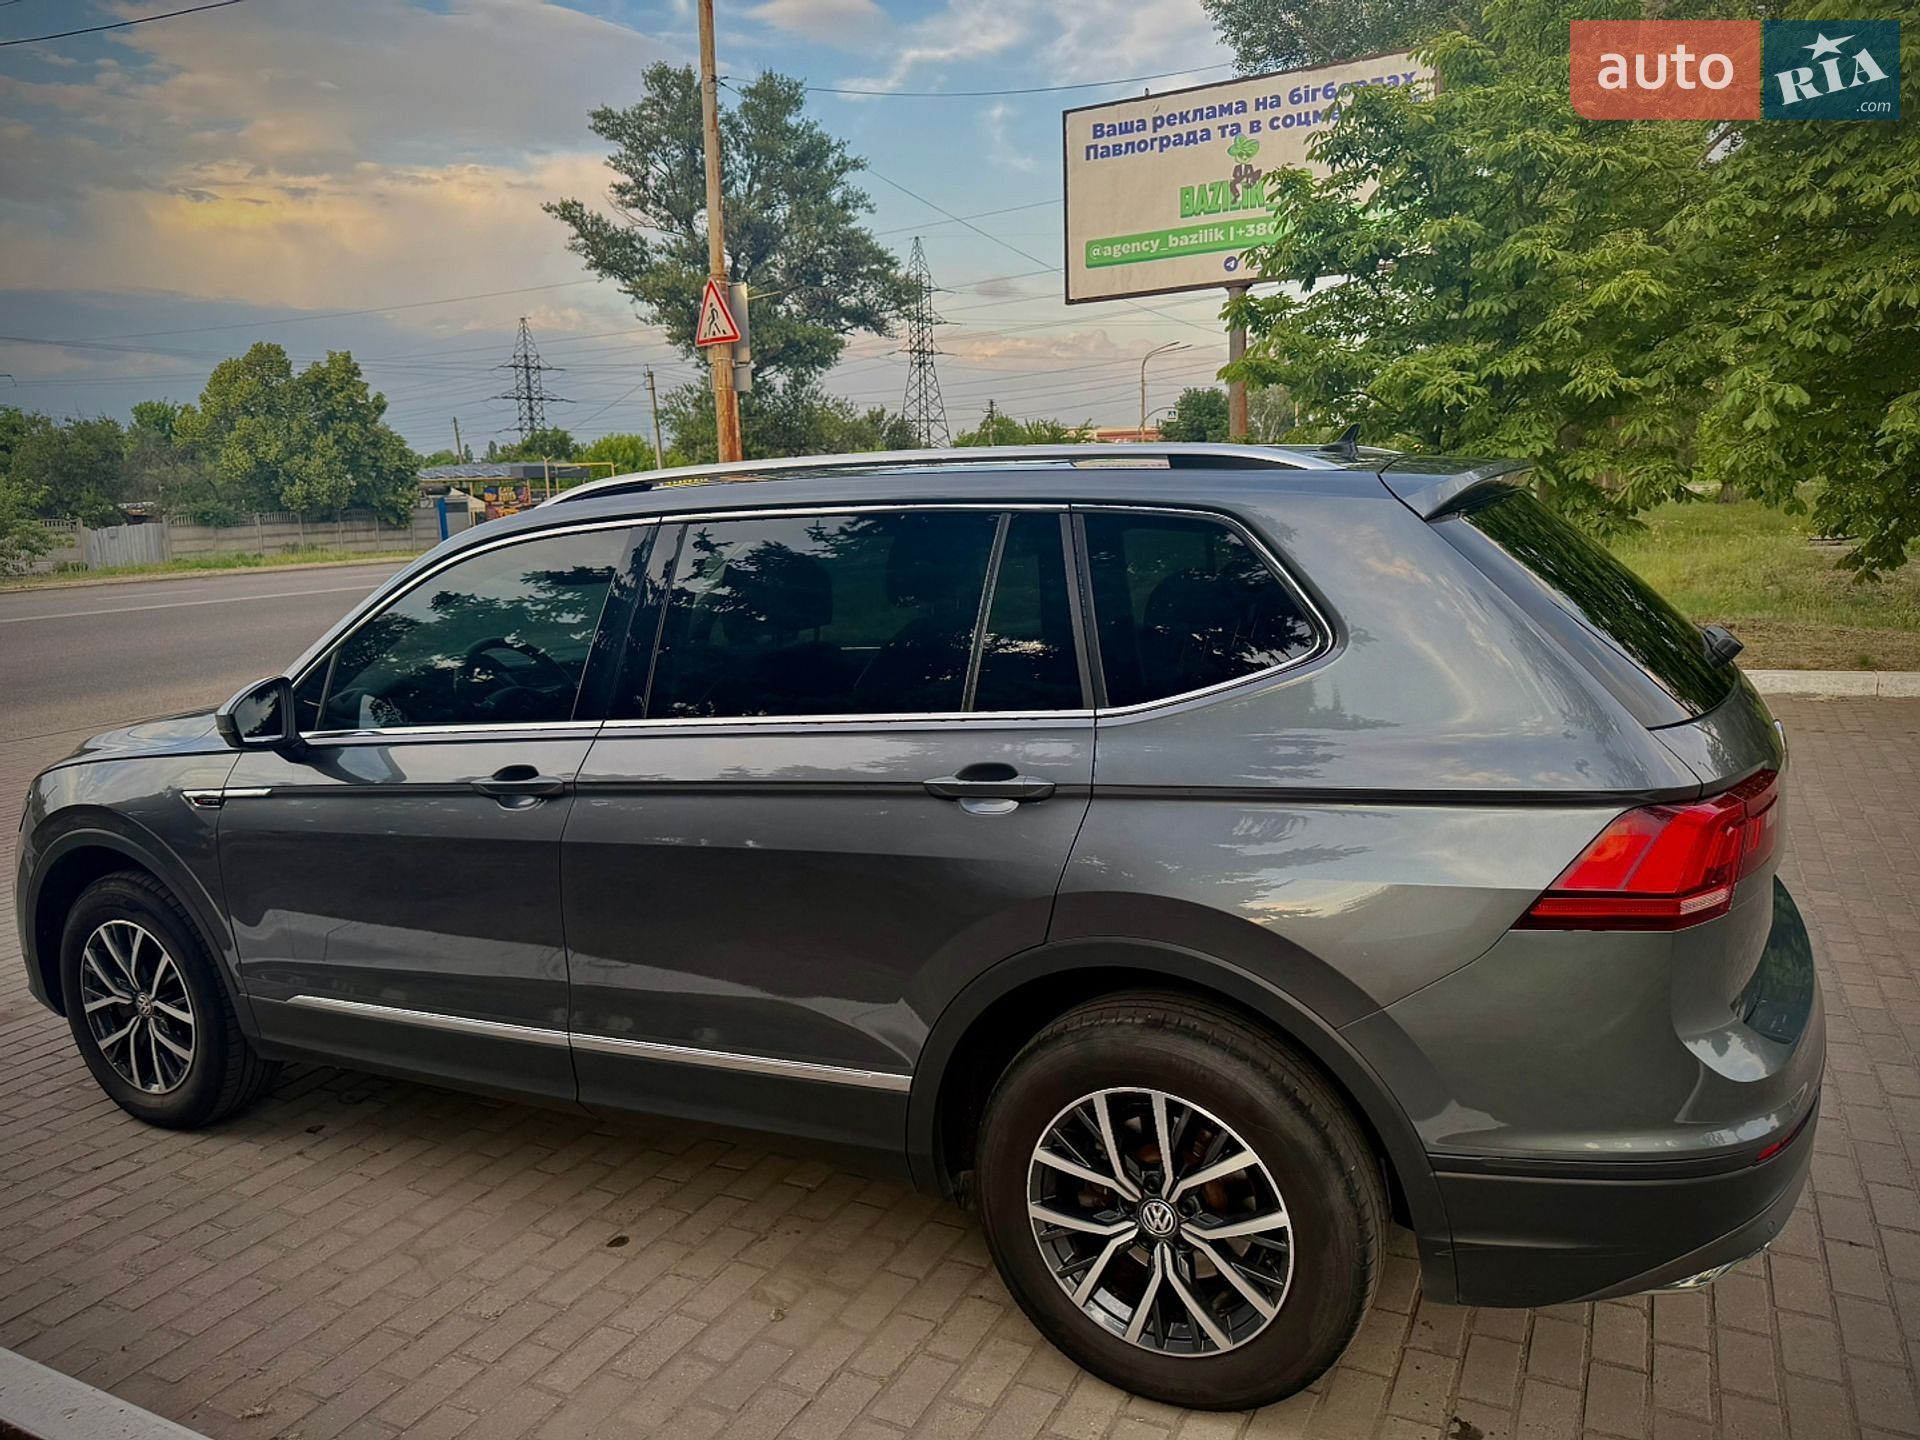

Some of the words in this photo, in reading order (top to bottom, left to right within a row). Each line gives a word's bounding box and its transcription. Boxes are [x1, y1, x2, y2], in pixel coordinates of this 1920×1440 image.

[1092, 118, 1147, 139] Ваша
[1152, 99, 1248, 133] реклама
[1254, 93, 1281, 111] на
[1085, 127, 1211, 161] Павлограда
[1217, 121, 1241, 139] та
[1249, 119, 1262, 134] в
[1090, 228, 1225, 258] @agency_bazilik
